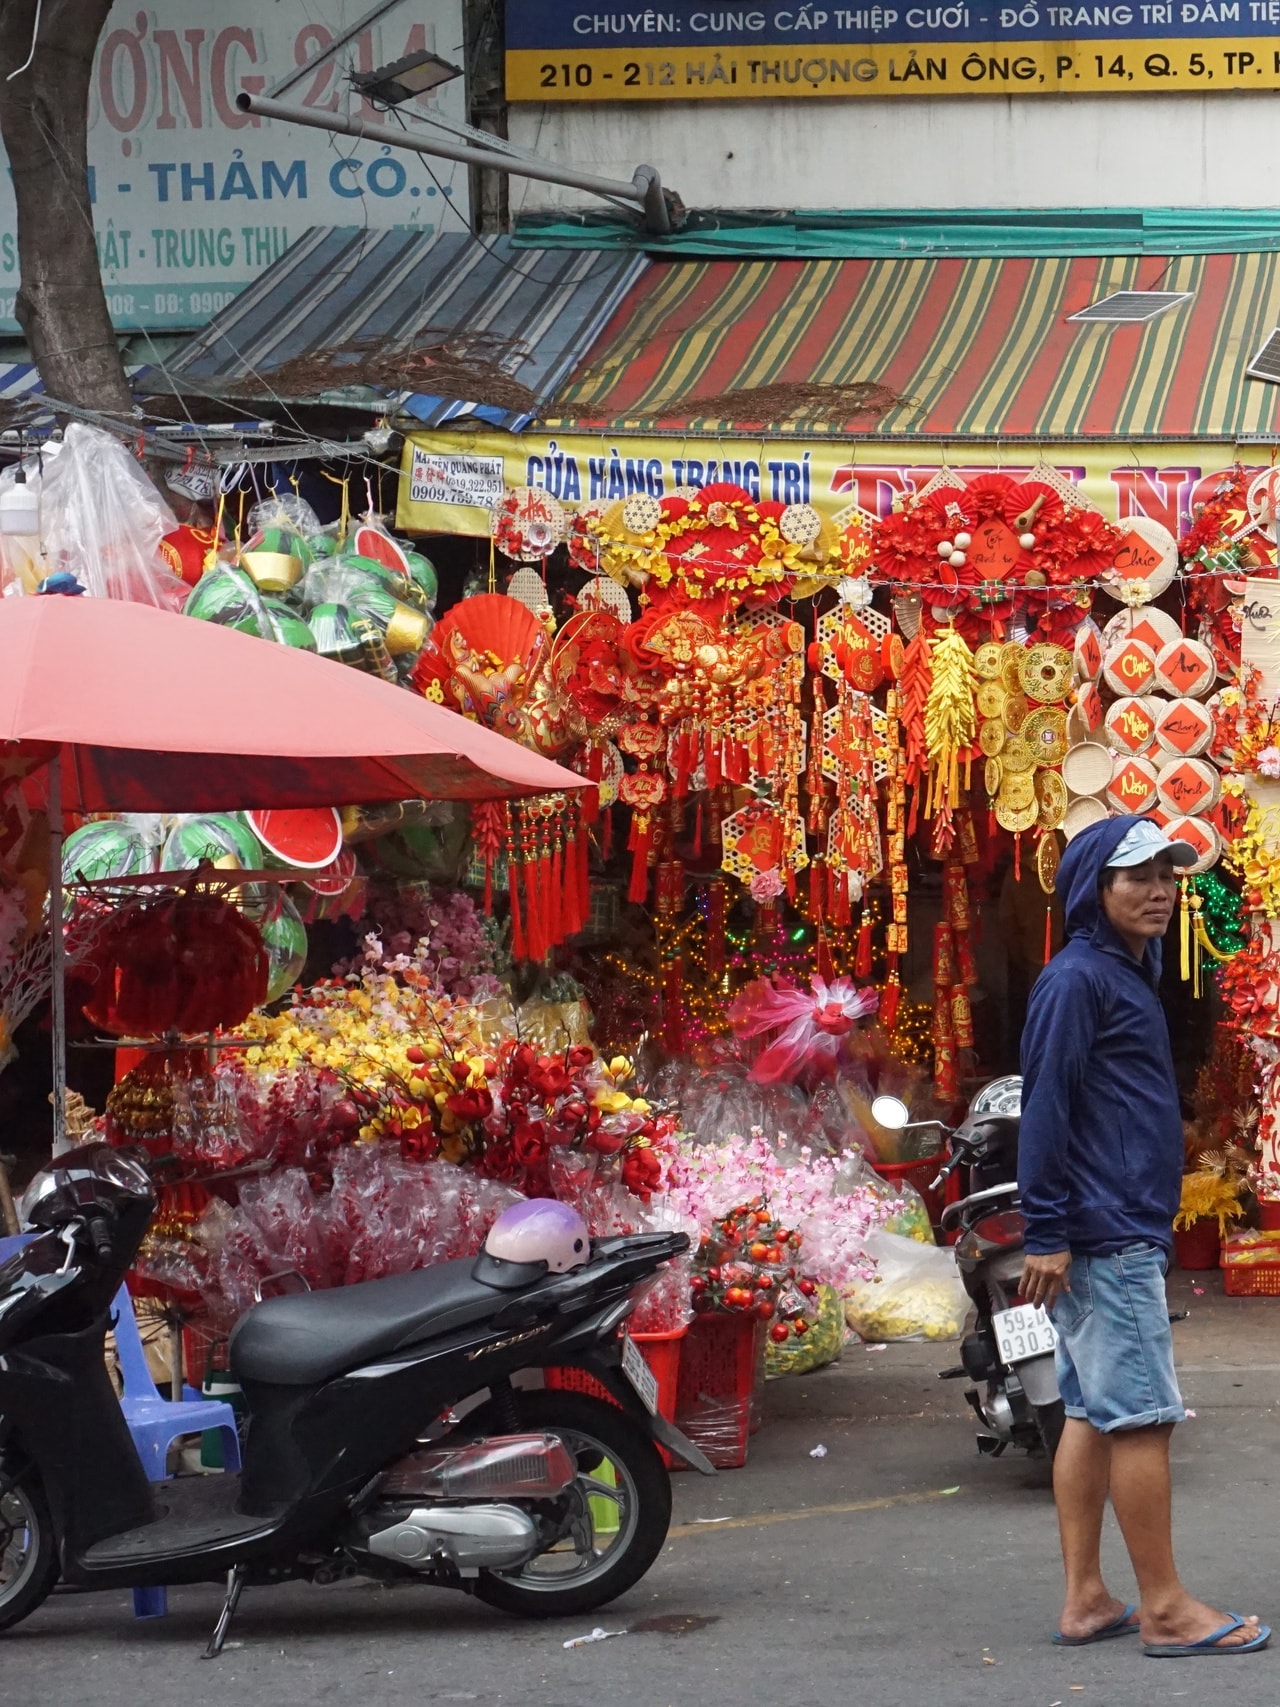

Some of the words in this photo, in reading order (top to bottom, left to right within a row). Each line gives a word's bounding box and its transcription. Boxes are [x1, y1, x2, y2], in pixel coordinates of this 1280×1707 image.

[573, 9, 682, 34] CHUYÊN:
[690, 11, 766, 32] CUNG
[774, 2, 828, 31] CẤP
[835, 6, 898, 36] THIỆP
[906, 3, 969, 29] CƯỚI
[1000, 0, 1039, 28] ĐỒ
[1048, 4, 1133, 27] TRANG
[101, 9, 270, 158] ỢNG
[540, 63, 593, 87] 210
[623, 61, 676, 86] 212
[686, 53, 737, 85] HẢI
[747, 57, 879, 88] THƯỢNG
[961, 52, 1046, 84] ÔNG,
[1056, 57, 1080, 79] P.
[1094, 55, 1134, 80] 14,
[1144, 53, 1178, 77] Q.
[1188, 53, 1214, 78] 5,
[1224, 51, 1263, 75] TP.
[148, 149, 308, 203] THẢM
[151, 228, 236, 269] TRUNG
[526, 441, 581, 502] CỬA
[590, 447, 664, 501] HÀNG
[761, 452, 813, 506] TRÍ
